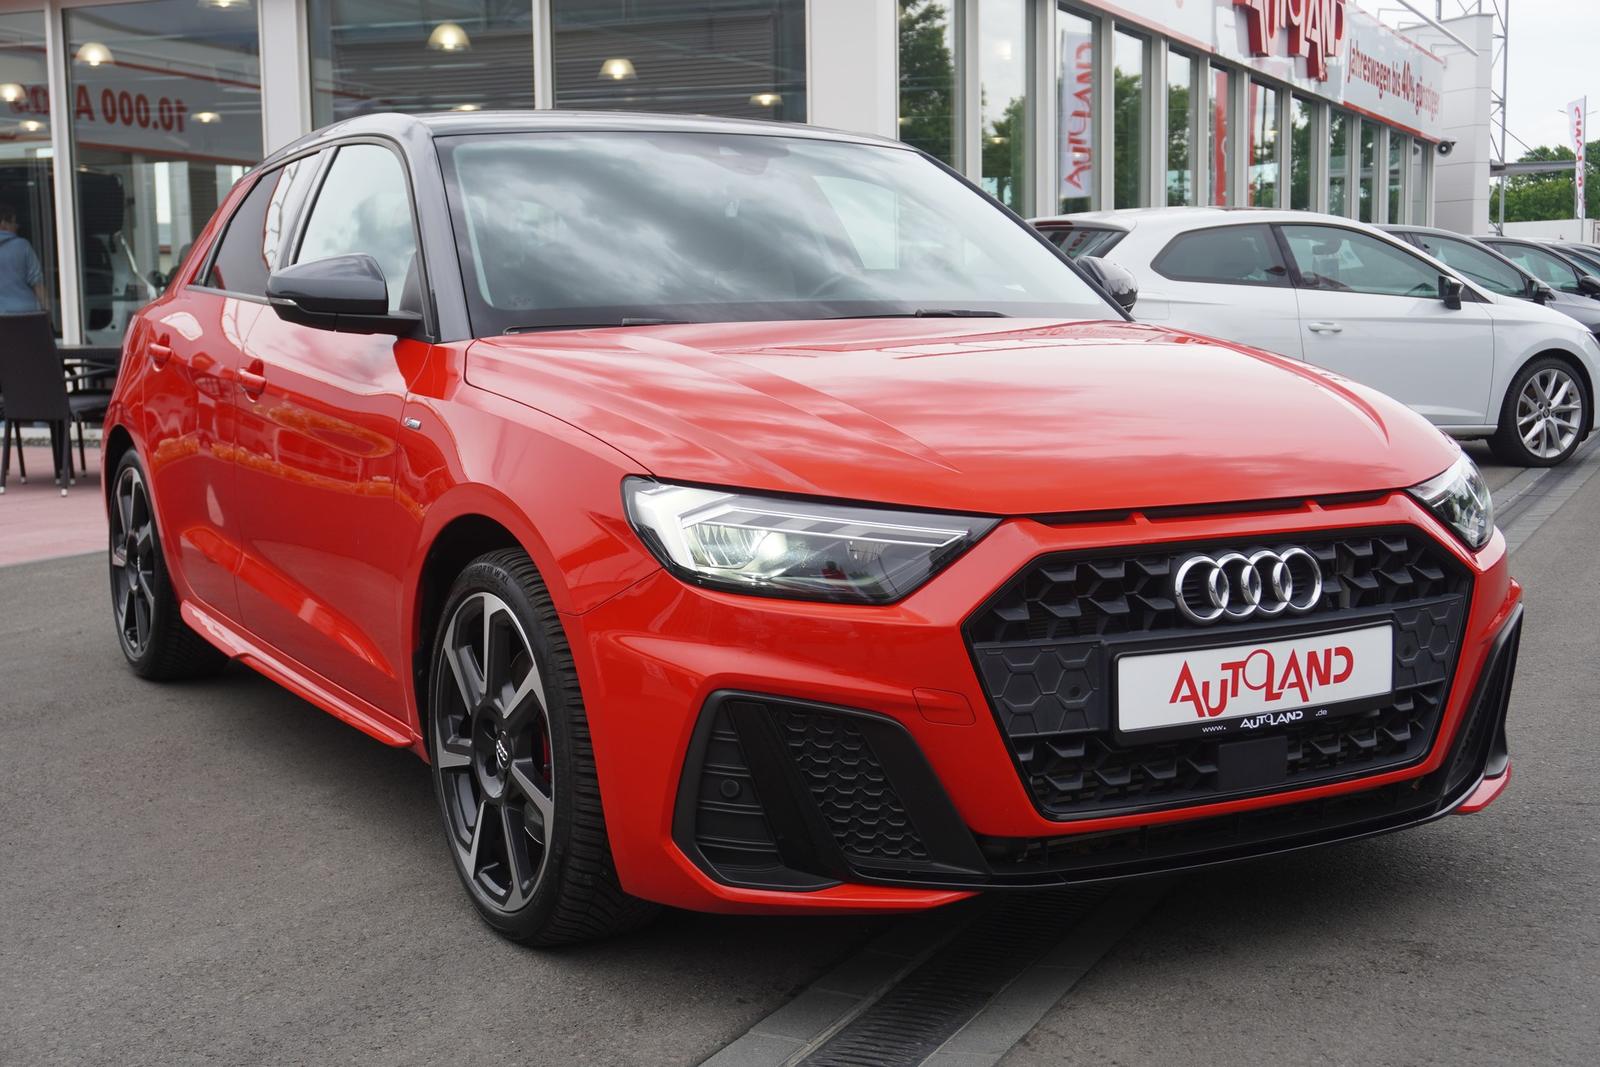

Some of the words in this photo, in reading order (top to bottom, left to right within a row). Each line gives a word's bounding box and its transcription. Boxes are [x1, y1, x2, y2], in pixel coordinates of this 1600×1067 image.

[1347, 38, 1391, 99] Jahreswagen
[1169, 646, 1354, 718] AUTOLAND
[1240, 711, 1304, 729] AUTOLAND
[1315, 709, 1328, 717] .de
